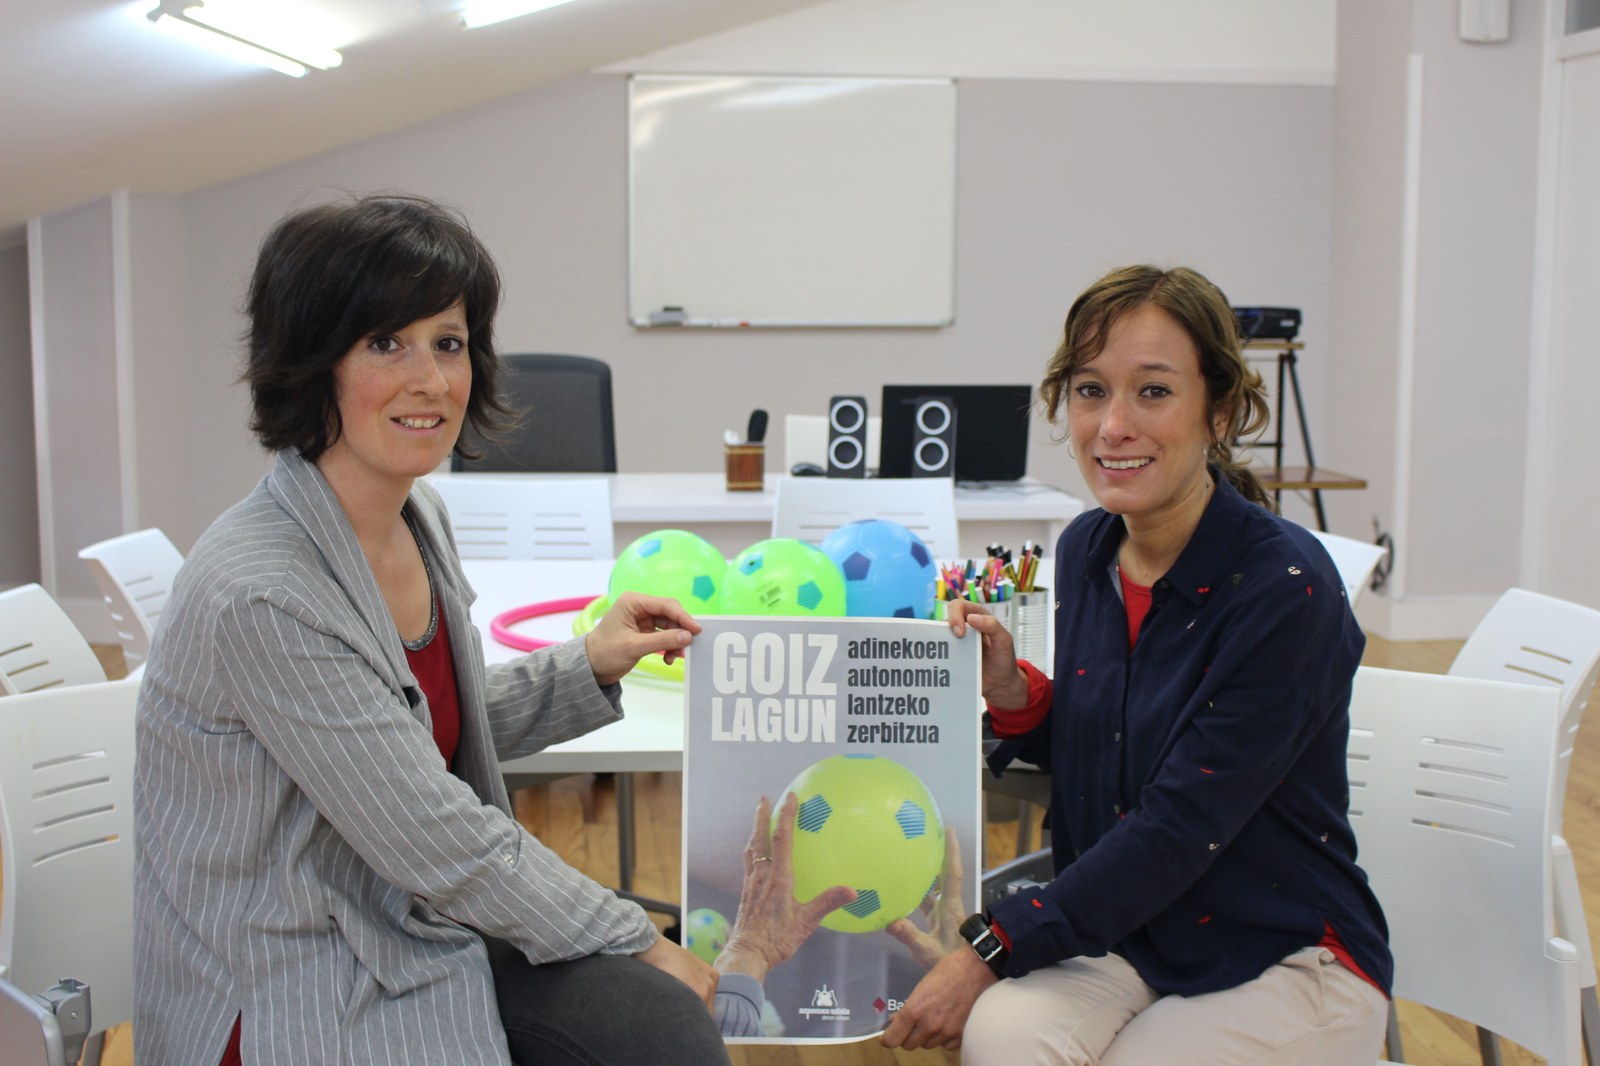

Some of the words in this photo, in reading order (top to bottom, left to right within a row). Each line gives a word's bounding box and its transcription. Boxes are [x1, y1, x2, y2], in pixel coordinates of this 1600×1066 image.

[848, 638, 949, 659] adinekoen
[713, 631, 838, 695] GOIZ
[847, 666, 950, 687] autonomia
[848, 694, 930, 715] lantzeko
[712, 697, 836, 743] LAGUN
[847, 722, 939, 743] zerbitzua
[887, 999, 907, 1011] Ba
